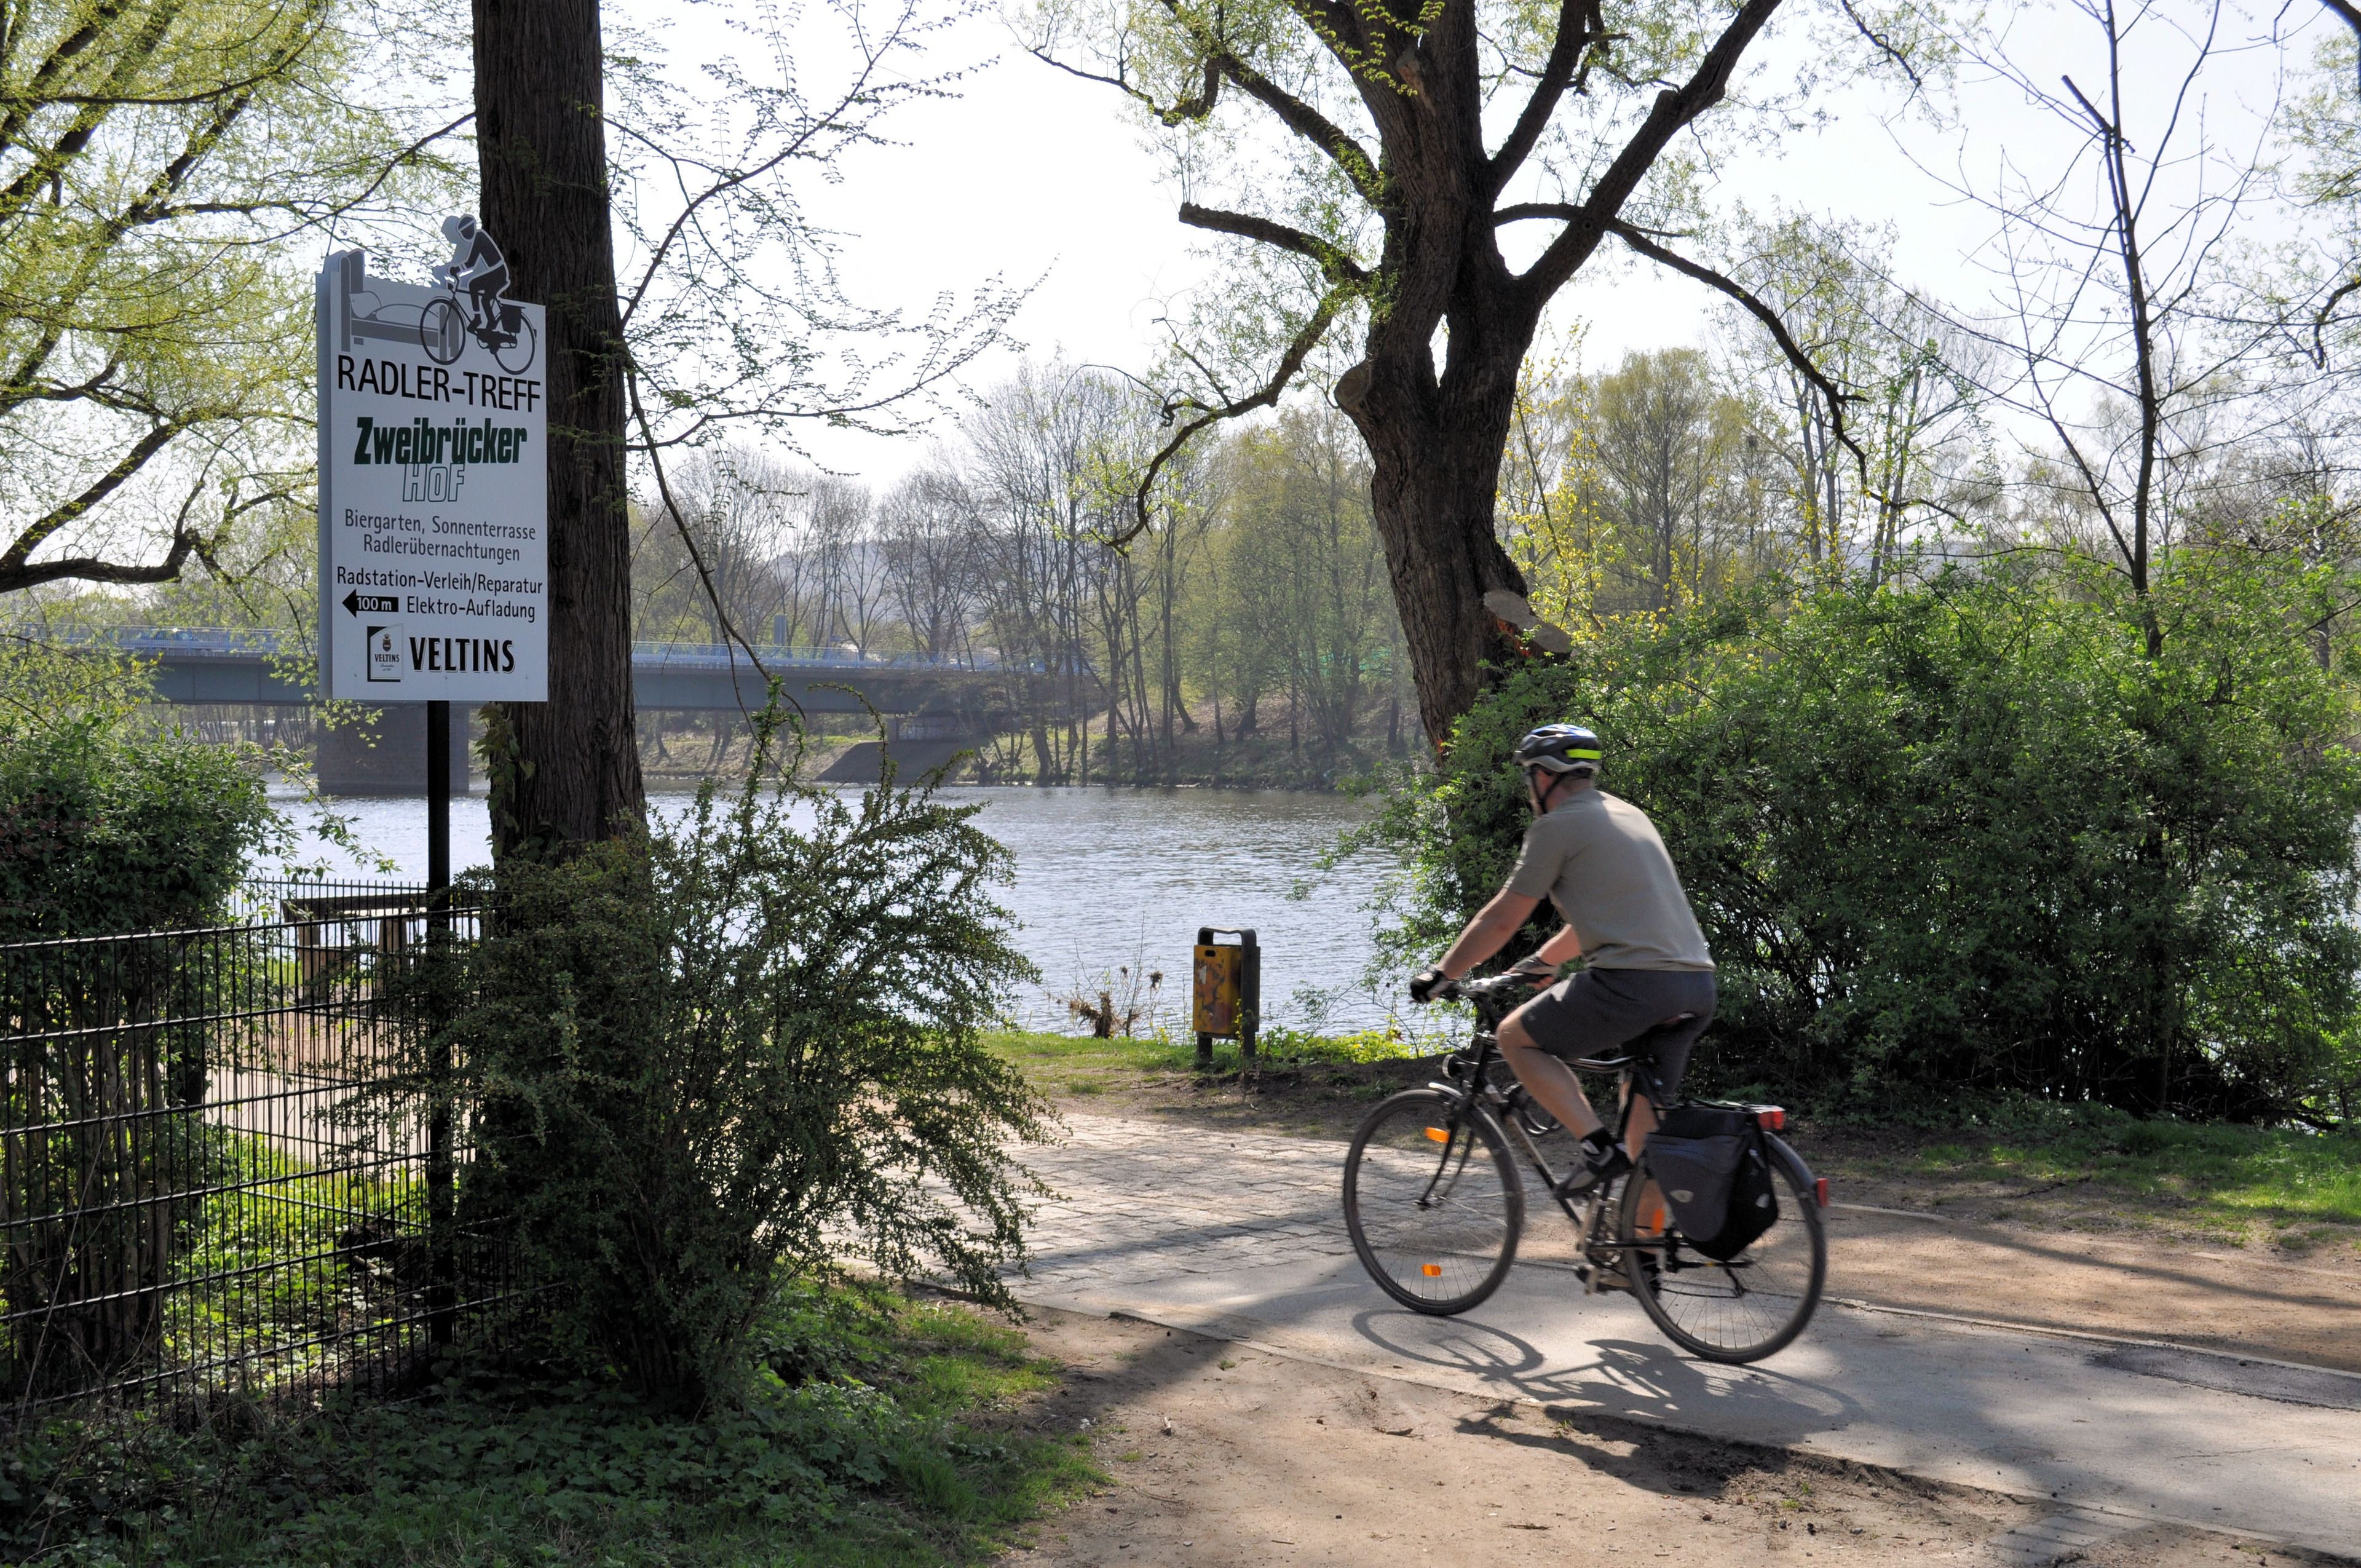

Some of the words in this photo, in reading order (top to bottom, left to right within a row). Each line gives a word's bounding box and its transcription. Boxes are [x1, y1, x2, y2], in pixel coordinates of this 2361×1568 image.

[338, 355, 540, 413] RADLER-TREFF
[354, 417, 528, 464] Zweibrücker
[403, 462, 464, 502] HOF
[345, 509, 425, 534] Biergarten,
[432, 516, 536, 540] Sonnenterrasse
[363, 534, 520, 564] Radlerübernachtungen
[337, 566, 543, 596] Radstation-Verleih/Reparatur
[357, 596, 379, 611] 100
[381, 600, 392, 611] m
[407, 596, 536, 623] Elektro-Aufladung
[374, 654, 400, 662] VELTINS
[409, 636, 515, 674] VELTINS
